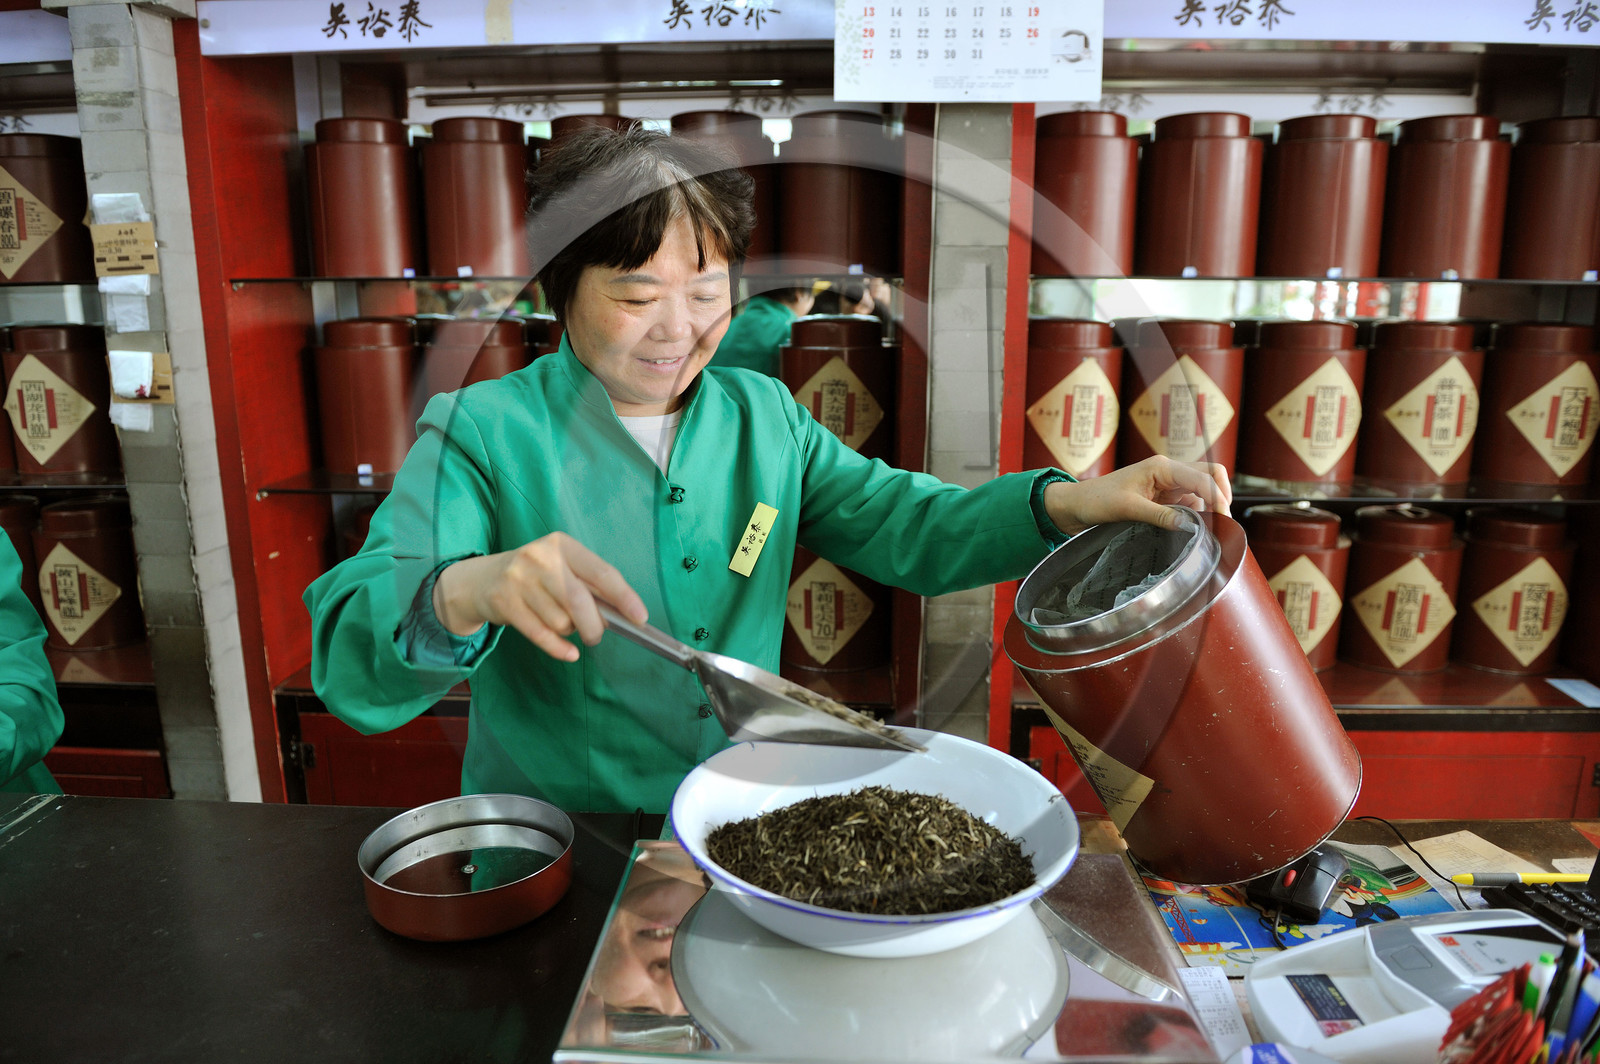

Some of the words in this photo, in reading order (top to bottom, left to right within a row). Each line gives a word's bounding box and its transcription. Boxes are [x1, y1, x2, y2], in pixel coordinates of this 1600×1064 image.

[864, 7, 875, 17] 13
[890, 7, 903, 17] 14
[917, 7, 930, 17] 15
[945, 7, 957, 17] 16
[972, 6, 984, 17] 17
[1000, 7, 1012, 17] 18
[1028, 7, 1040, 17] 19
[862, 28, 875, 38] 20
[889, 28, 901, 38] 21
[917, 28, 929, 38] 22
[944, 28, 957, 38] 23
[972, 28, 984, 38] 24
[999, 28, 1011, 38] 25
[1027, 28, 1039, 38] 26
[863, 48, 874, 59] 27
[889, 49, 902, 59] 28
[917, 49, 929, 59] 29
[944, 49, 956, 59] 30
[972, 49, 983, 59] 31
[817, 623, 832, 637] 70
